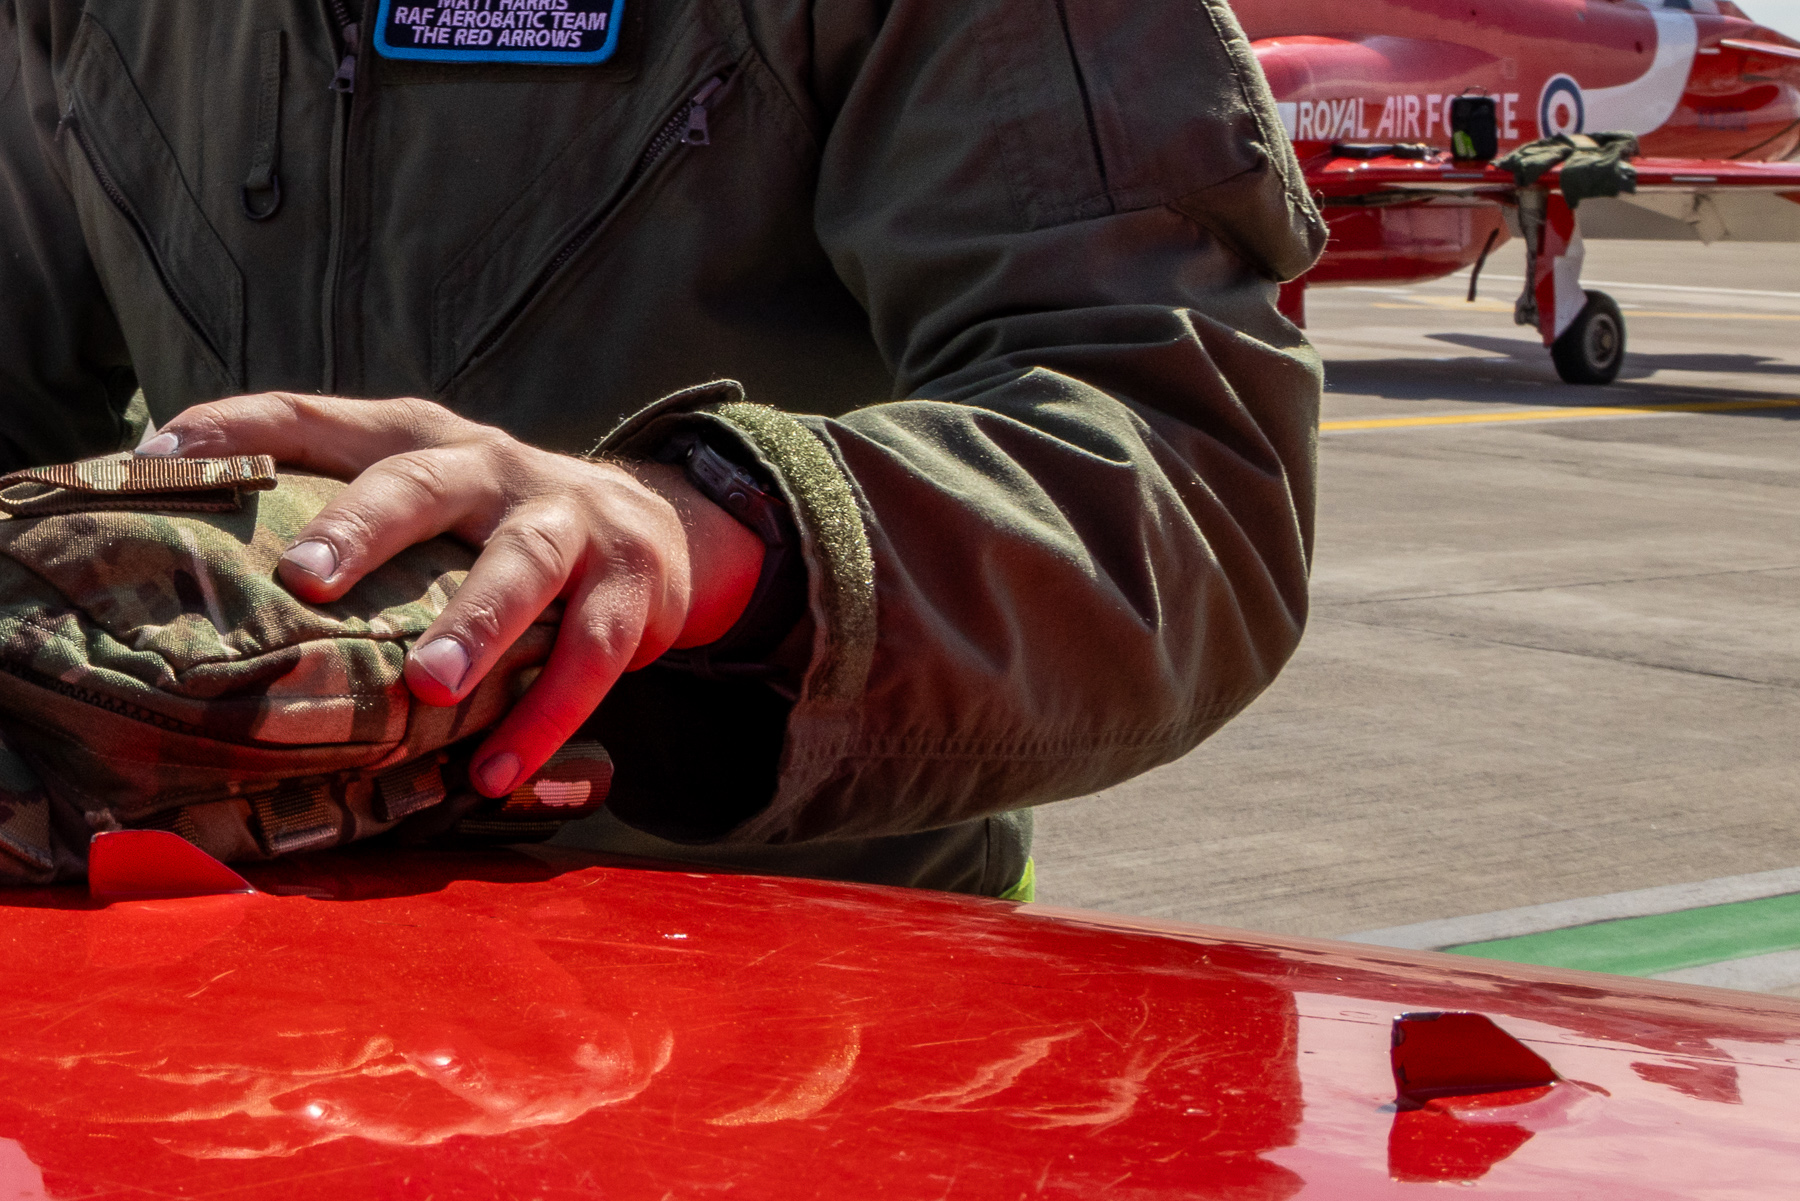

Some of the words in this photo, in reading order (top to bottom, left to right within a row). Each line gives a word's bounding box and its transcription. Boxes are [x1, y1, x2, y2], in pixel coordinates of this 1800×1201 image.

[394, 6, 435, 26] RAF
[437, 9, 546, 29] AEROBATIC
[551, 12, 607, 31] TEAM
[412, 25, 450, 45] THE
[454, 27, 493, 47] RED
[497, 29, 583, 49] ARROWS
[1300, 98, 1370, 141] ROYAL
[1375, 94, 1421, 139] AIR
